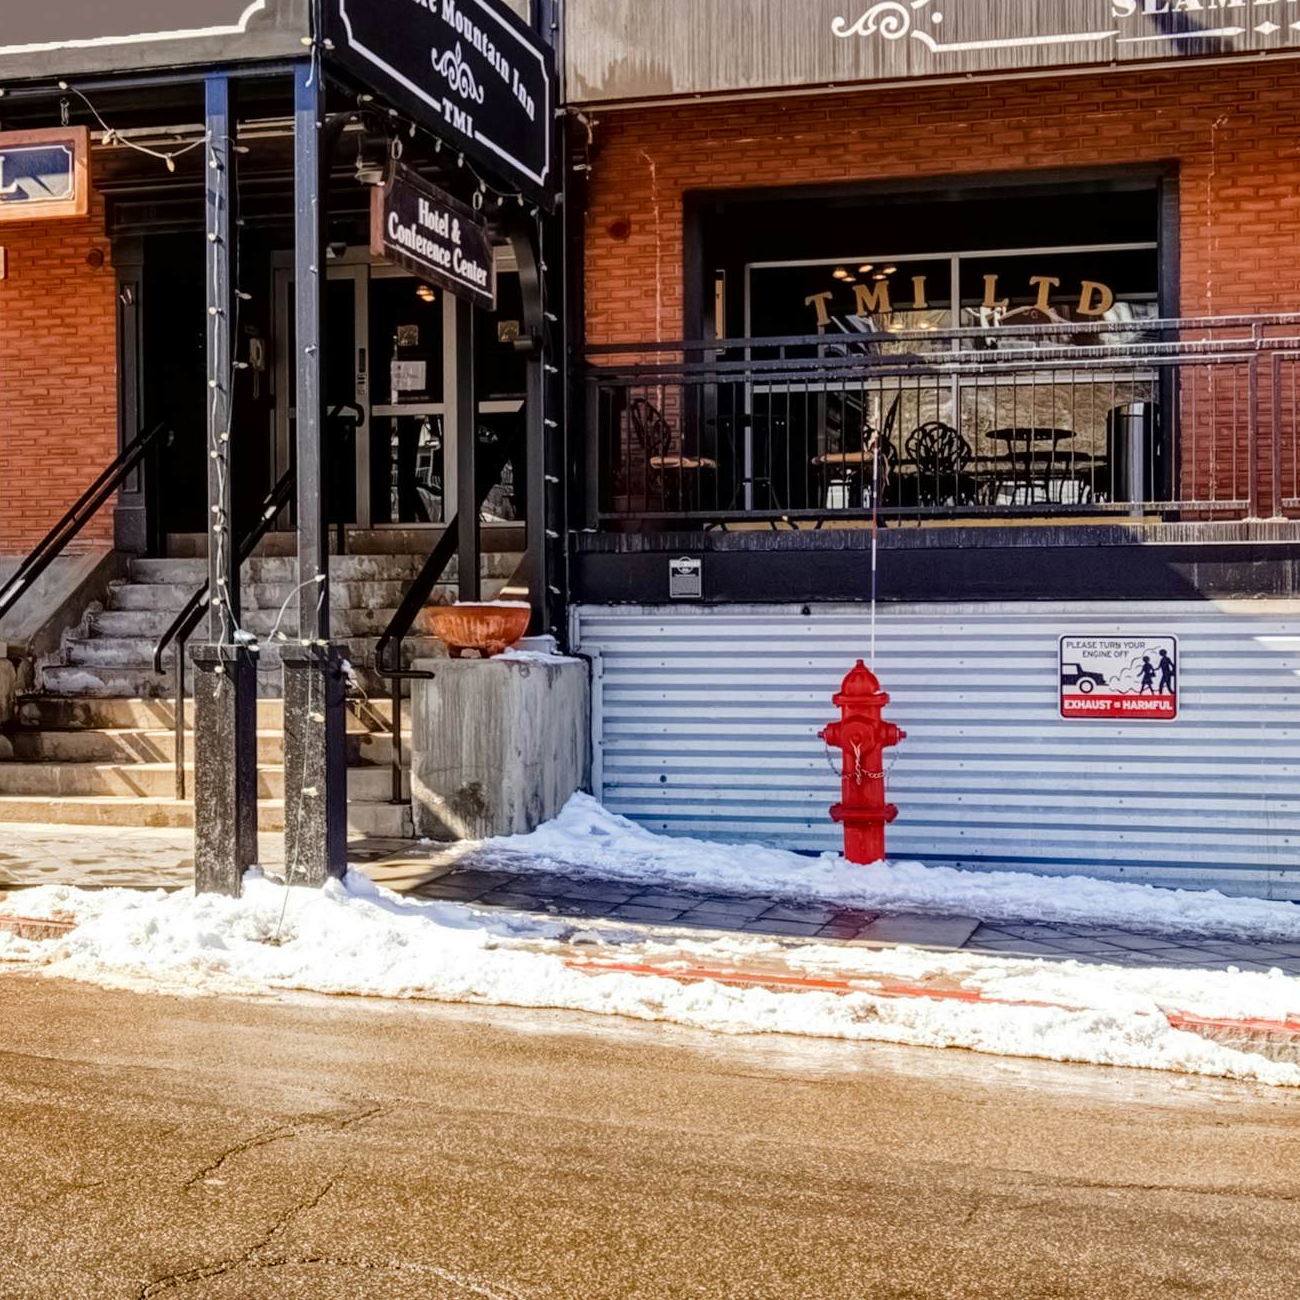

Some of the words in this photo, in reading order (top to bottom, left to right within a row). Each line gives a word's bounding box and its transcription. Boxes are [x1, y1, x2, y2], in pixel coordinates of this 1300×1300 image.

[512, 67, 536, 122] Inn
[442, 97, 474, 138] TMI
[418, 197, 450, 239] Hotel
[451, 218, 462, 245] &
[388, 211, 452, 268] Conference
[453, 247, 488, 287] Center
[805, 275, 929, 326] TMI
[982, 274, 1114, 316] LTD
[1066, 641, 1098, 649] PLEASE
[1100, 641, 1122, 649] TURN
[1123, 641, 1146, 649] YOUR
[1082, 650, 1112, 658] ENGINE
[1114, 650, 1130, 658] OFF
[1064, 700, 1112, 710] EXHAUST
[1122, 700, 1173, 710] HARMFUL
